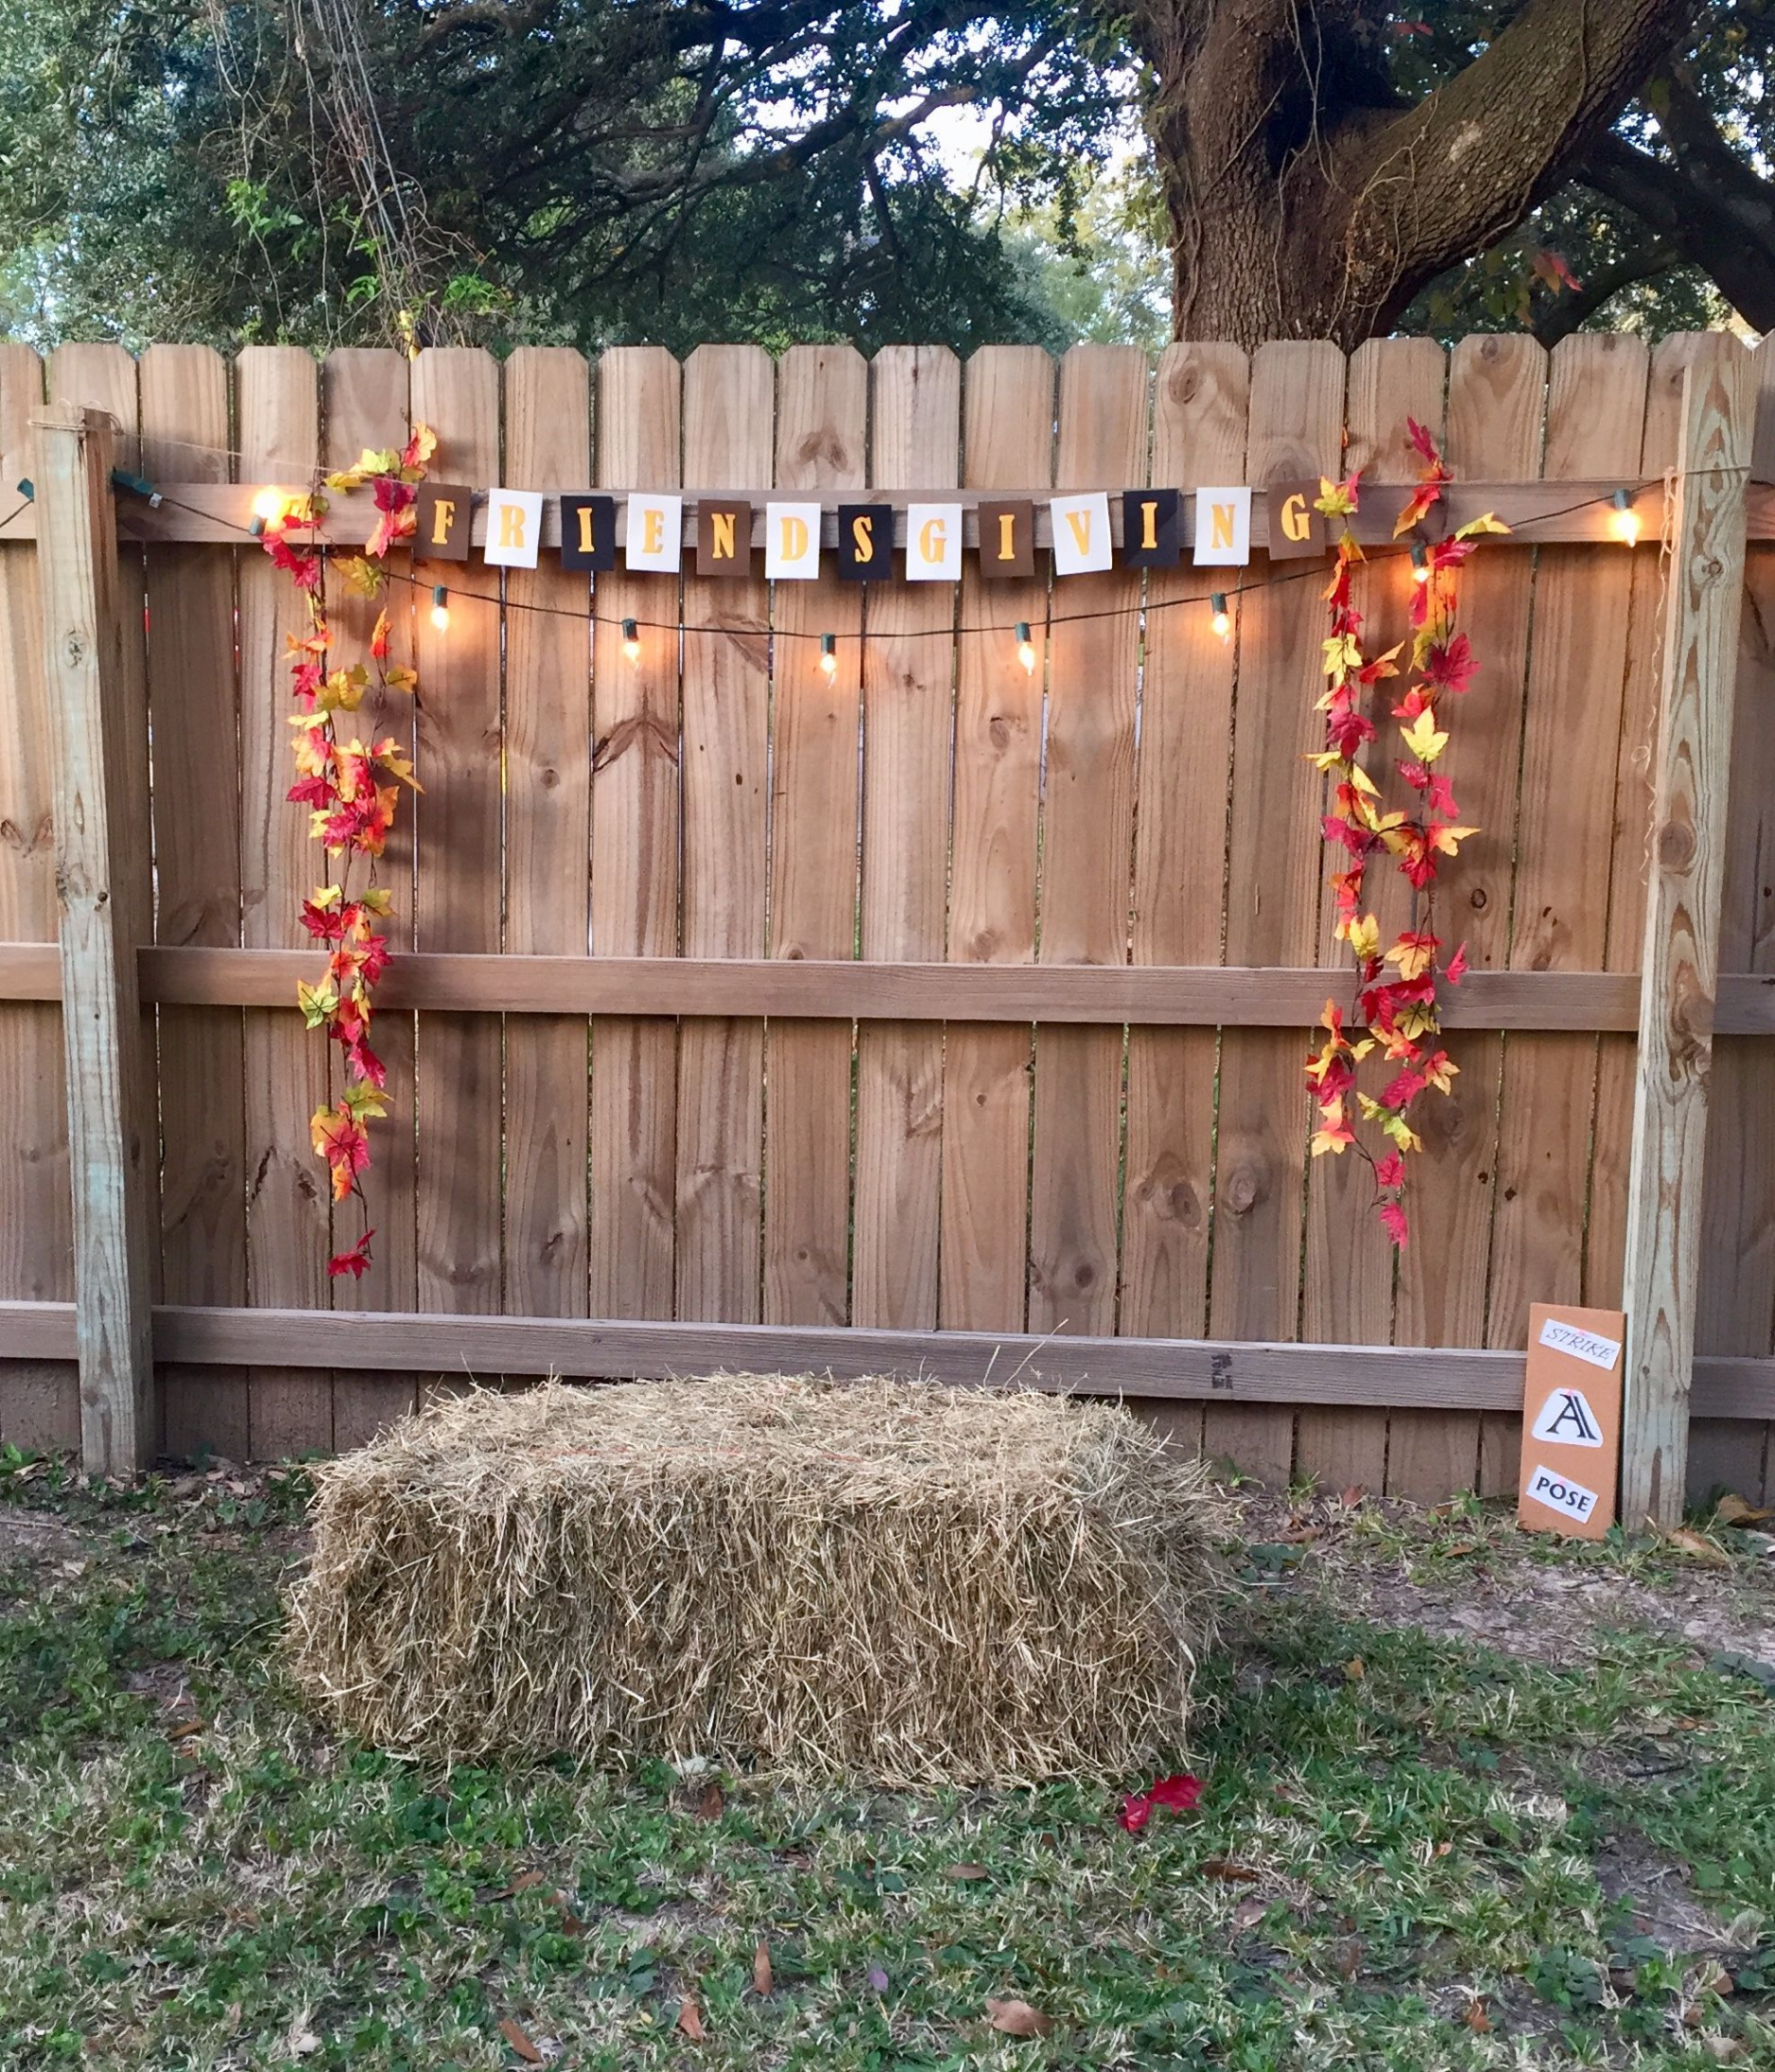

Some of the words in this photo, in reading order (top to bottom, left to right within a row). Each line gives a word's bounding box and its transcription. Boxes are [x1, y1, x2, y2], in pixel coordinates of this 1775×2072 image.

[430, 494, 1312, 565] FRIENDSGIVING
[1545, 1327, 1616, 1360] STRIKE
[1546, 1393, 1597, 1439] A
[1536, 1476, 1591, 1512] POSE
